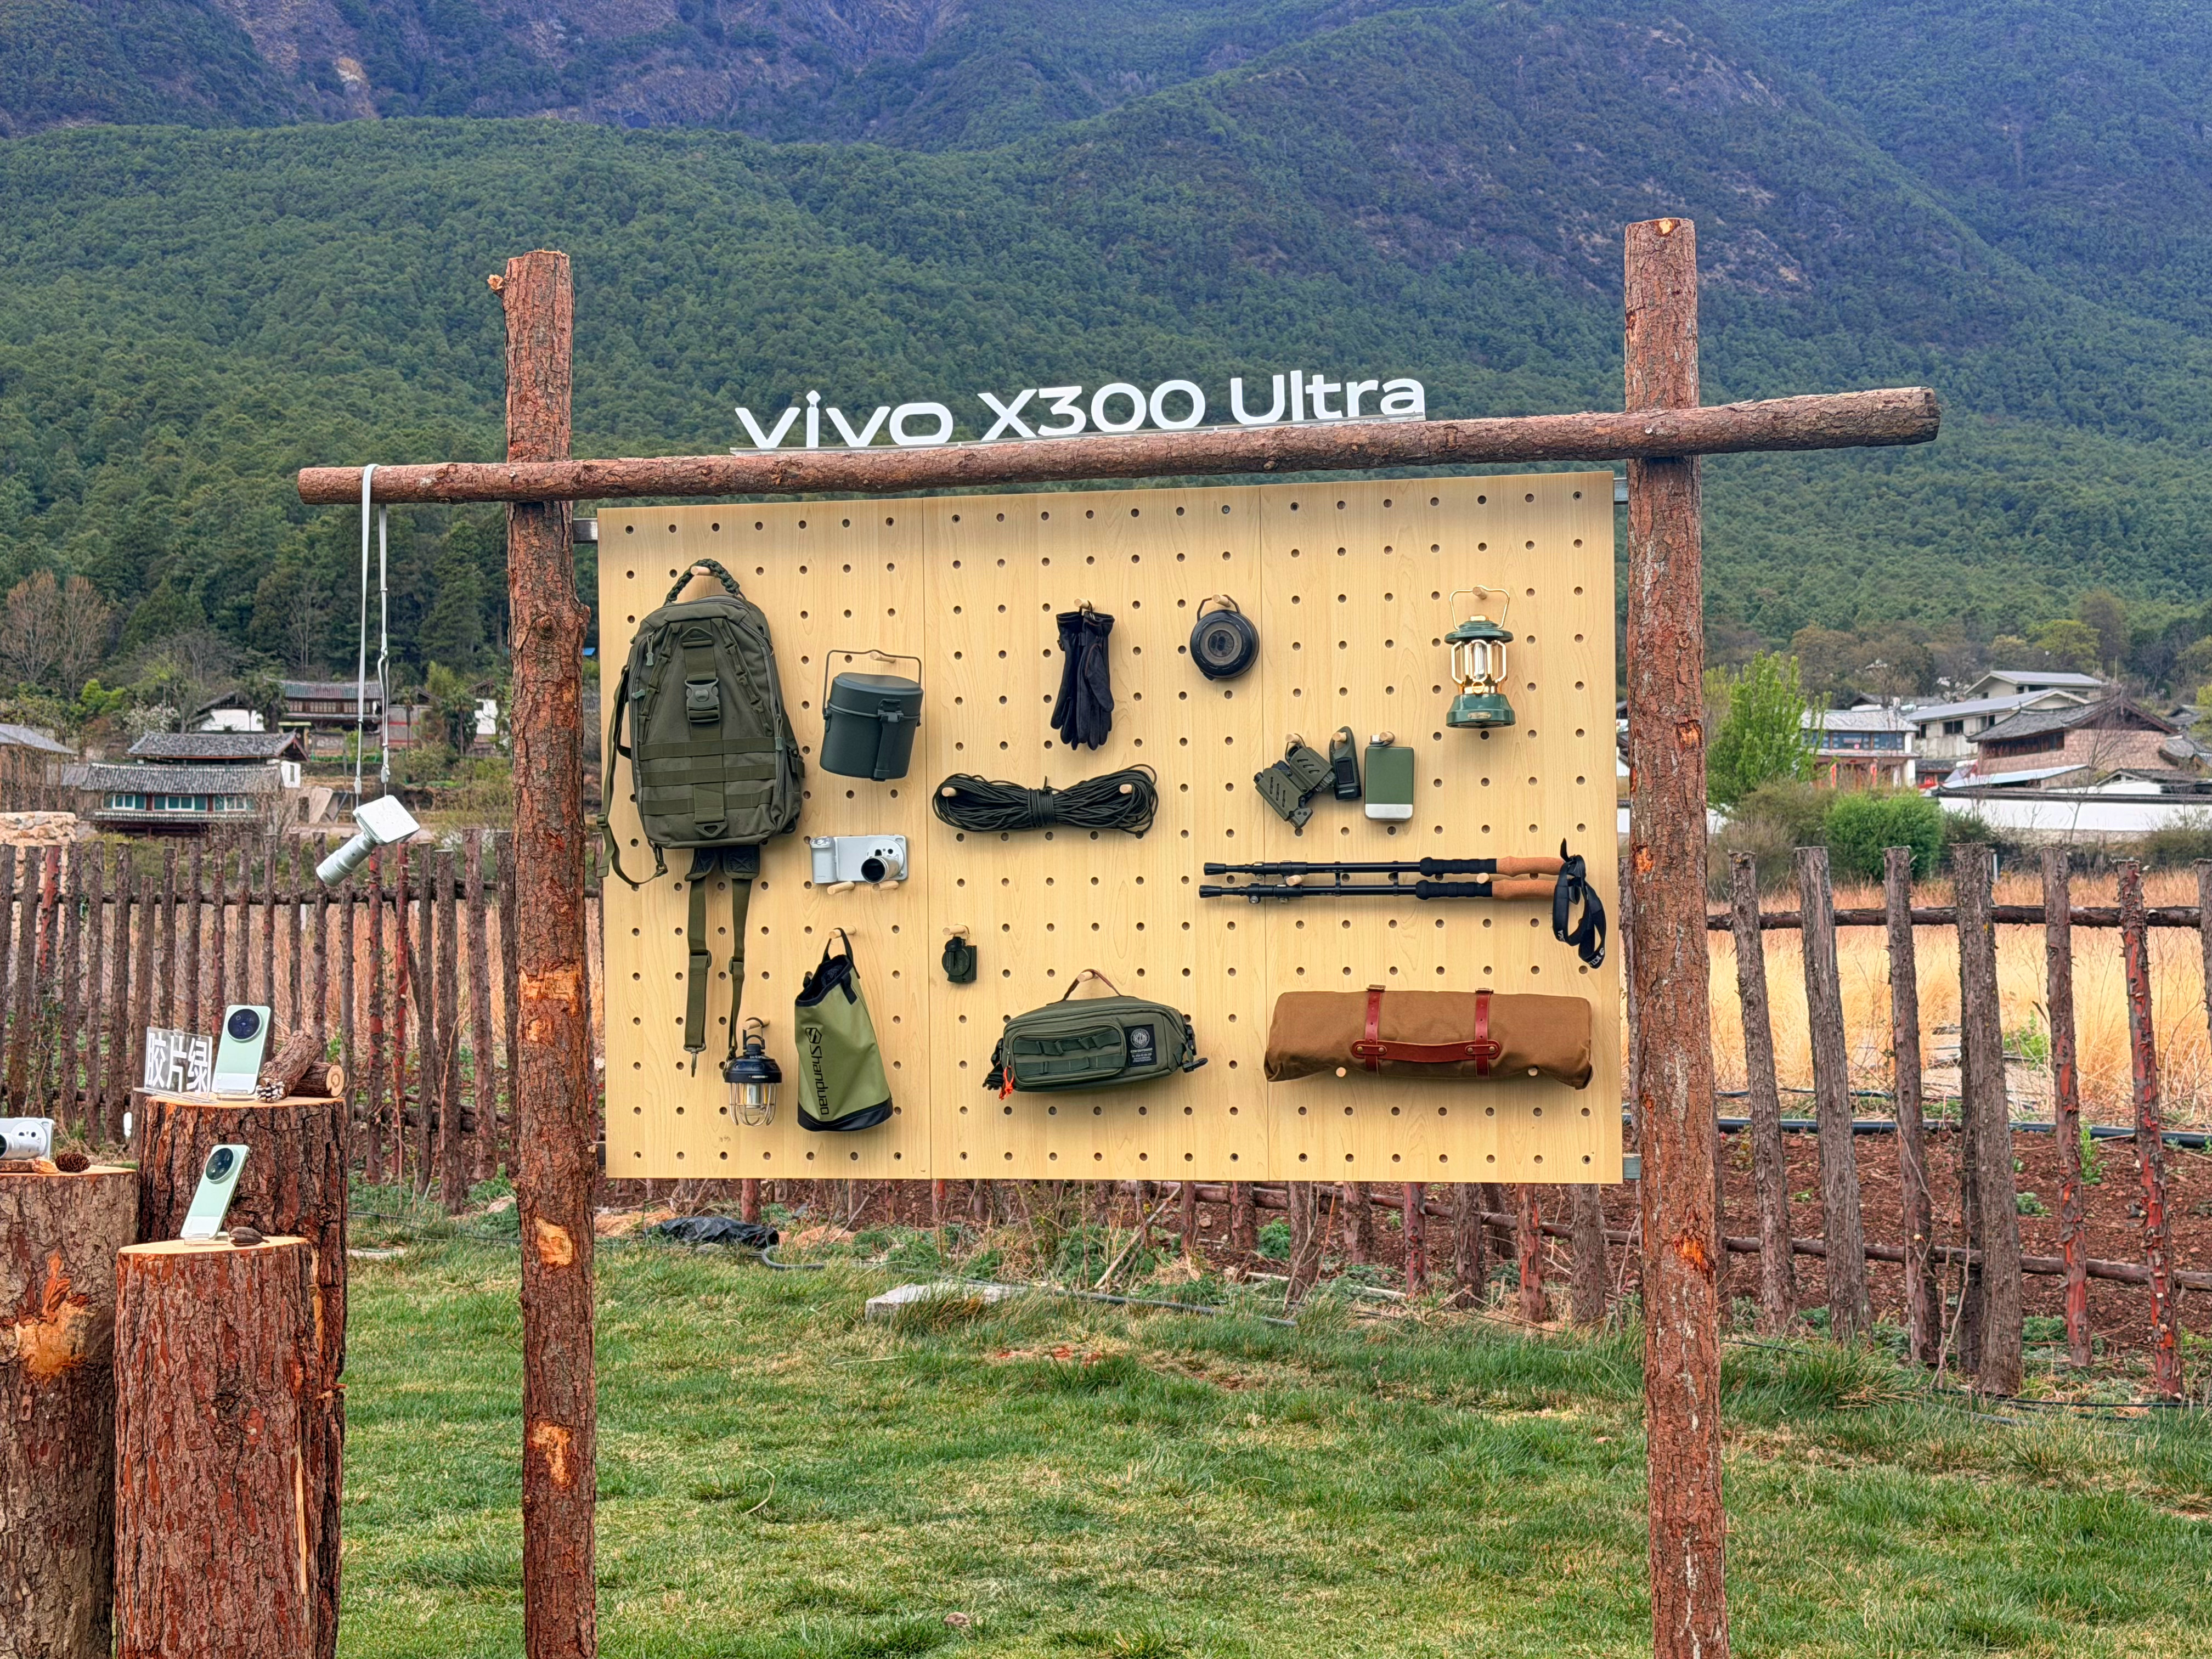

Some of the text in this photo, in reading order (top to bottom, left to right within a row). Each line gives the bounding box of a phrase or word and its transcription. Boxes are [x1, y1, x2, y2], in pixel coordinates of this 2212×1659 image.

[735, 370, 1425, 448] vivo X300 Ultra
[146, 1031, 208, 1096] 胶片绿
